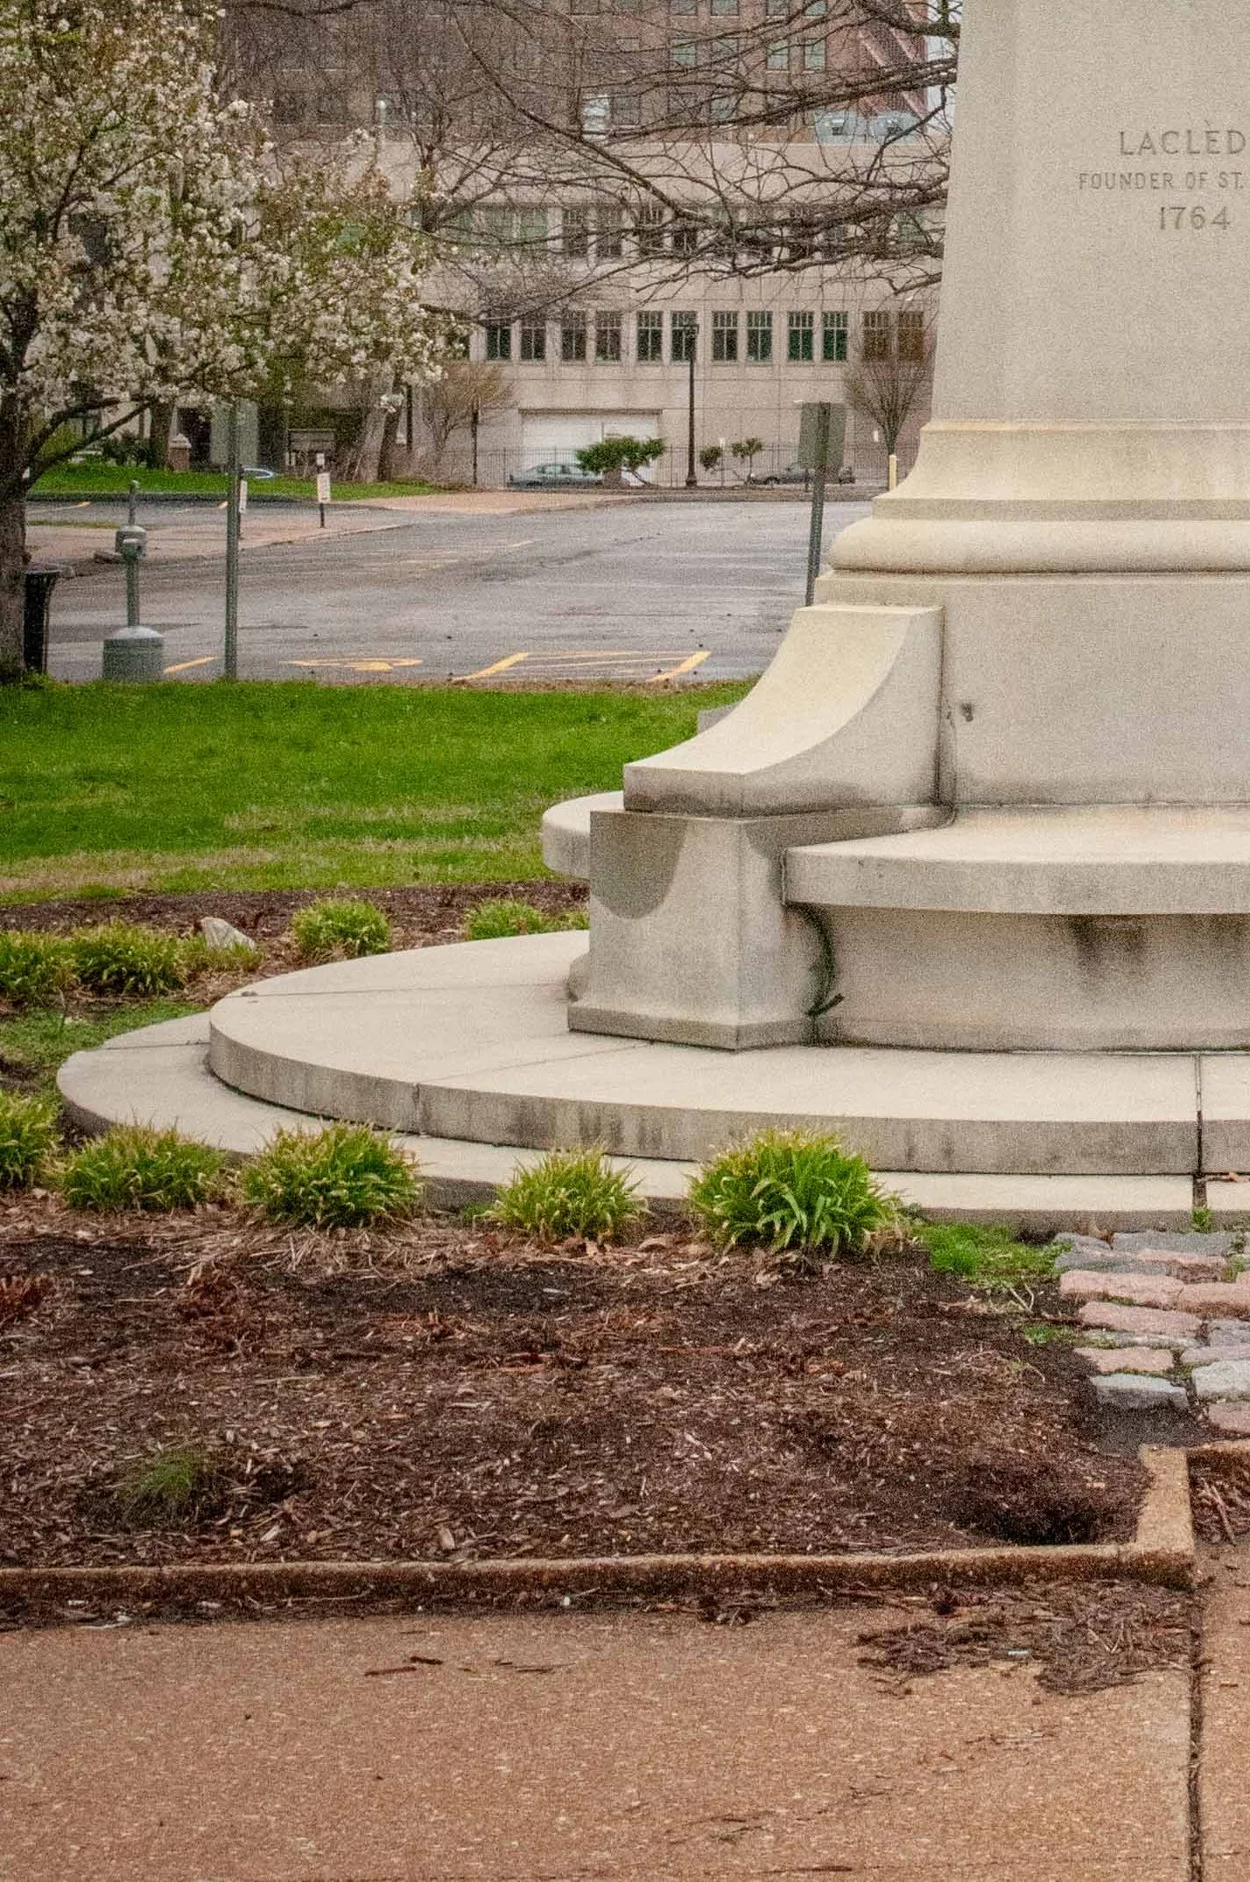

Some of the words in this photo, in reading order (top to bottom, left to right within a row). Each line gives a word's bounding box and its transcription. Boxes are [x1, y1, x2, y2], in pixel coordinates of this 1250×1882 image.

[1078, 172, 1174, 190] FOUNDER
[1185, 172, 1209, 190] OF
[1217, 171, 1244, 189] ST.
[1159, 206, 1231, 231] 1764
